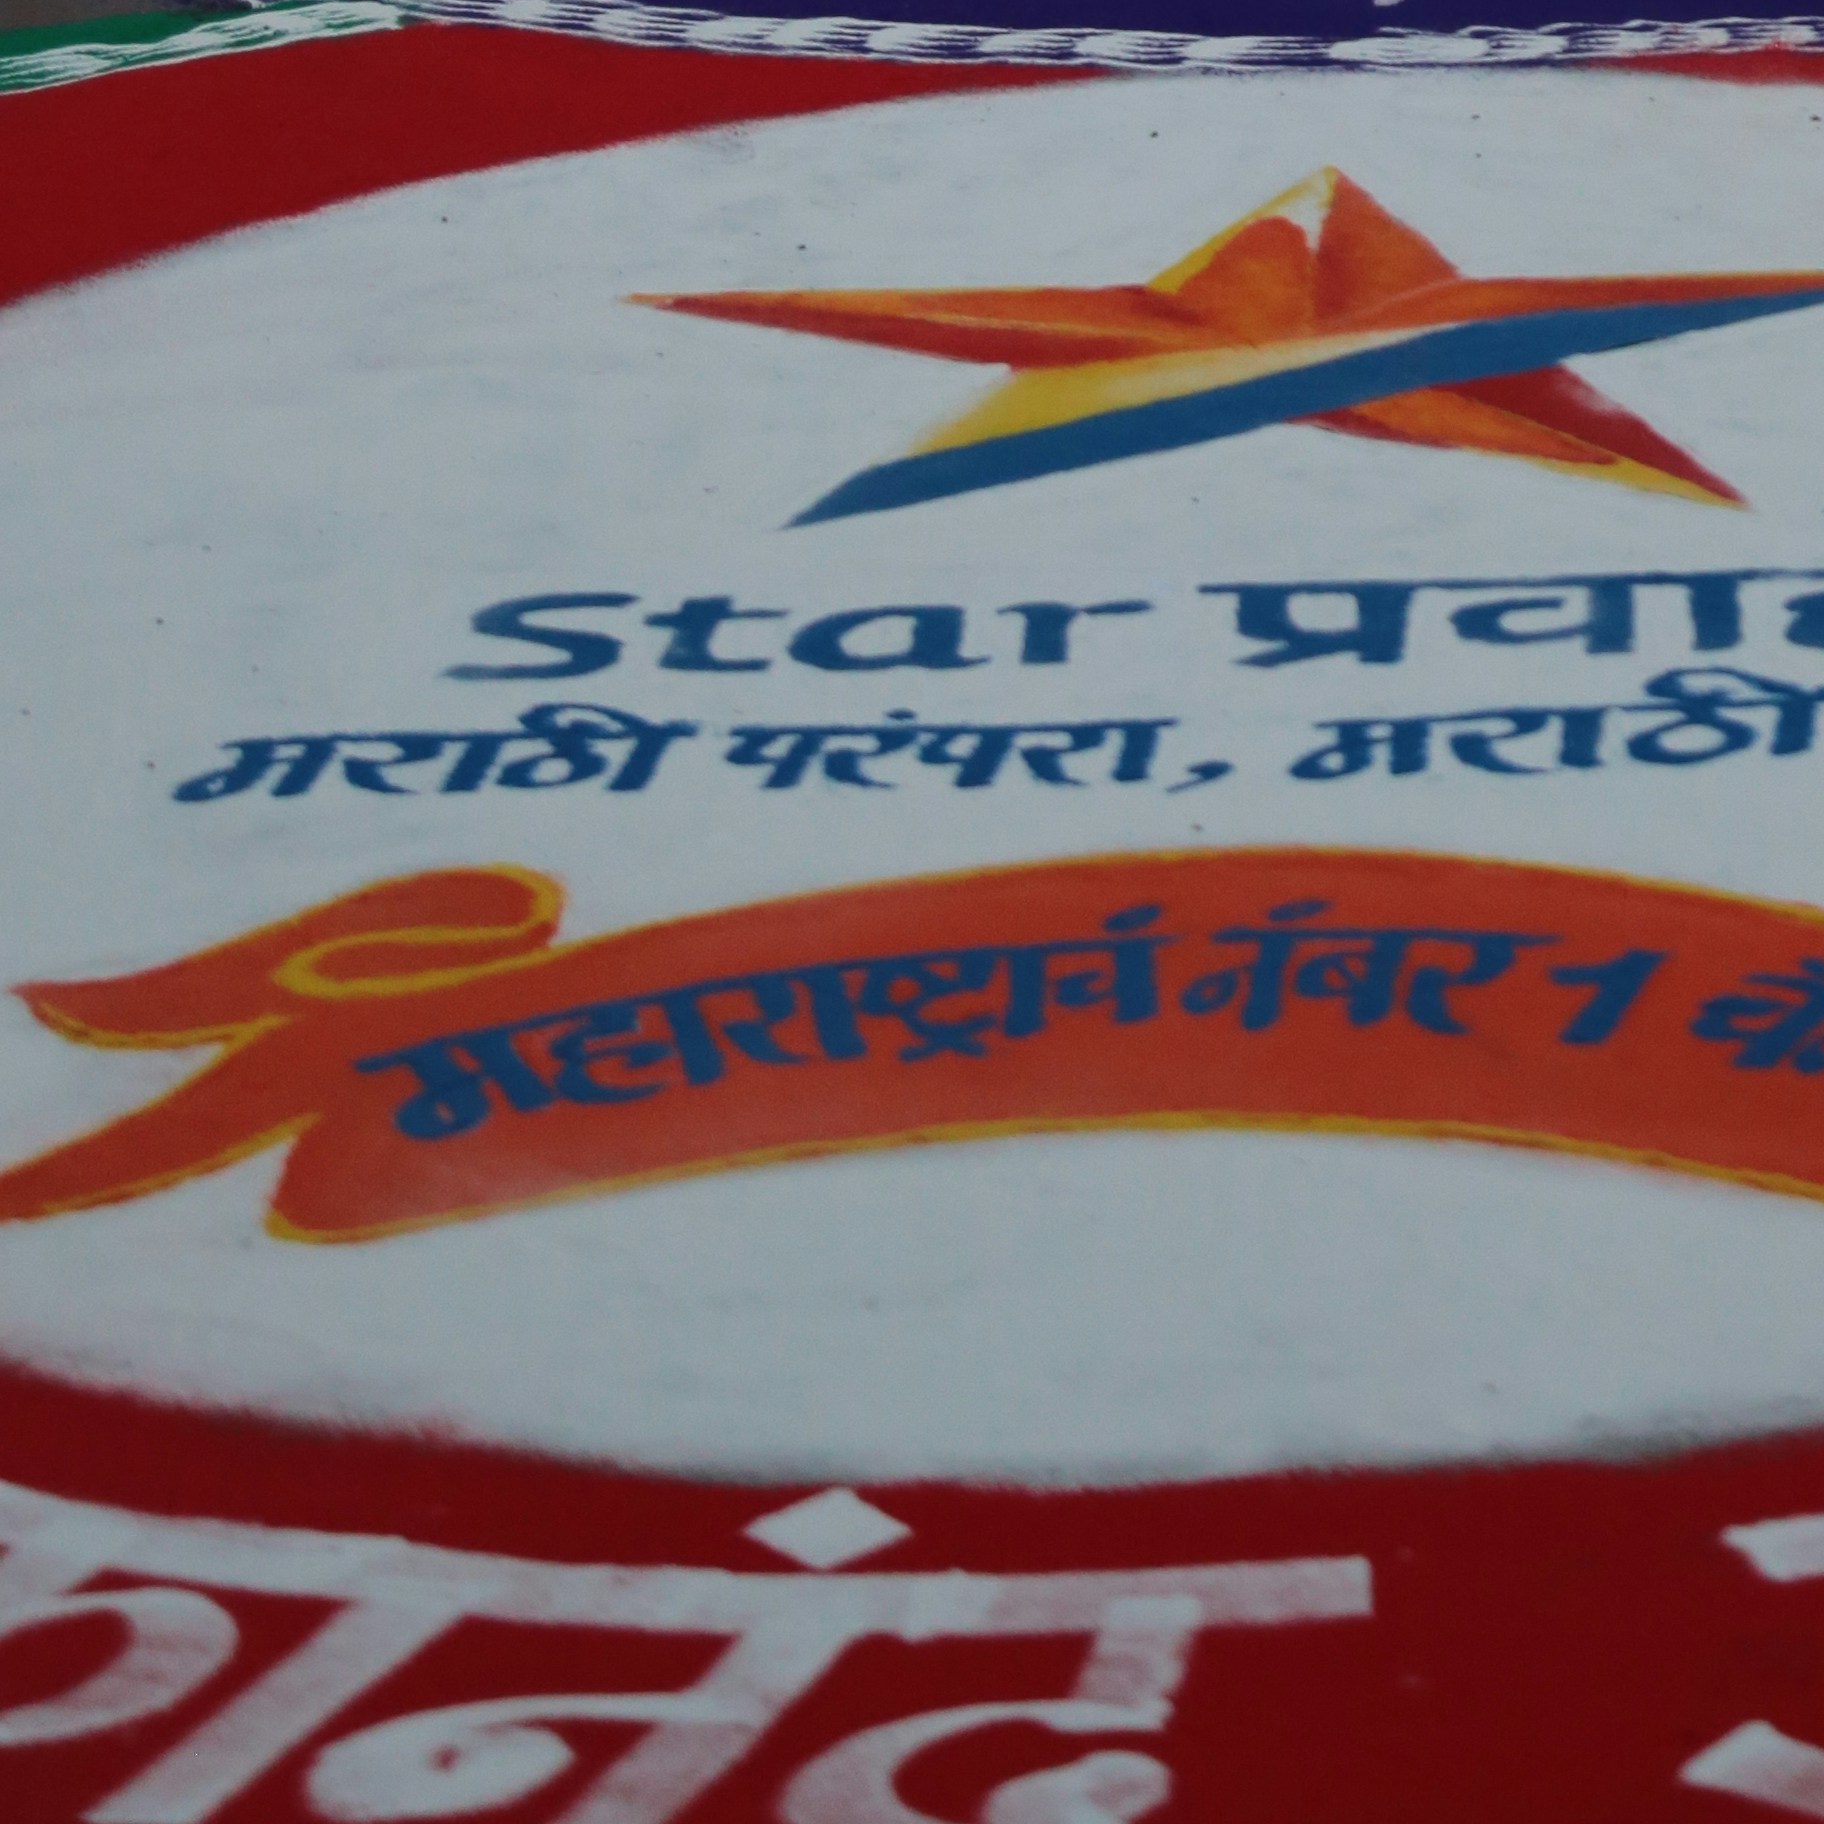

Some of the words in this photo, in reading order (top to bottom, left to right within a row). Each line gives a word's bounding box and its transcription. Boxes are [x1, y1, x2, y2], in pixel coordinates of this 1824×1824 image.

[438, 592, 1155, 681] Star
[173, 702, 698, 804] मराठी
[1180, 898, 1564, 1035] नंबर
[1548, 946, 1674, 1046] 1
